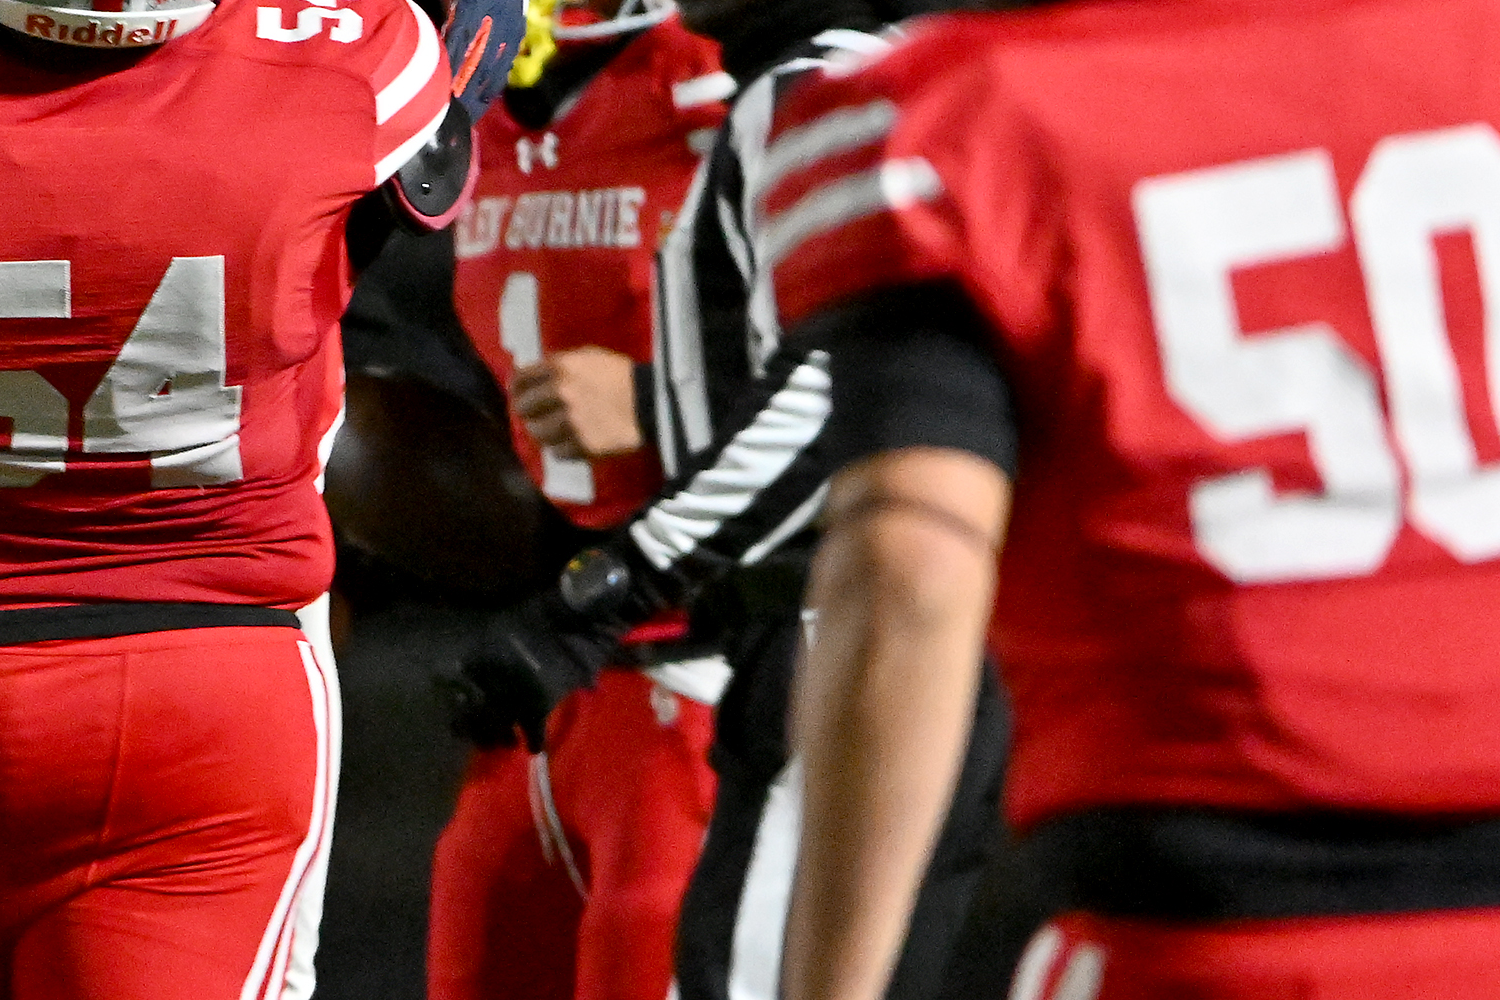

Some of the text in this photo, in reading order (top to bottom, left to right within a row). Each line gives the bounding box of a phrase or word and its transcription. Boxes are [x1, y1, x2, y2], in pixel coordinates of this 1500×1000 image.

[25, 14, 181, 46] Riddell
[505, 186, 647, 249] BURNIE
[1132, 122, 1500, 584] 50
